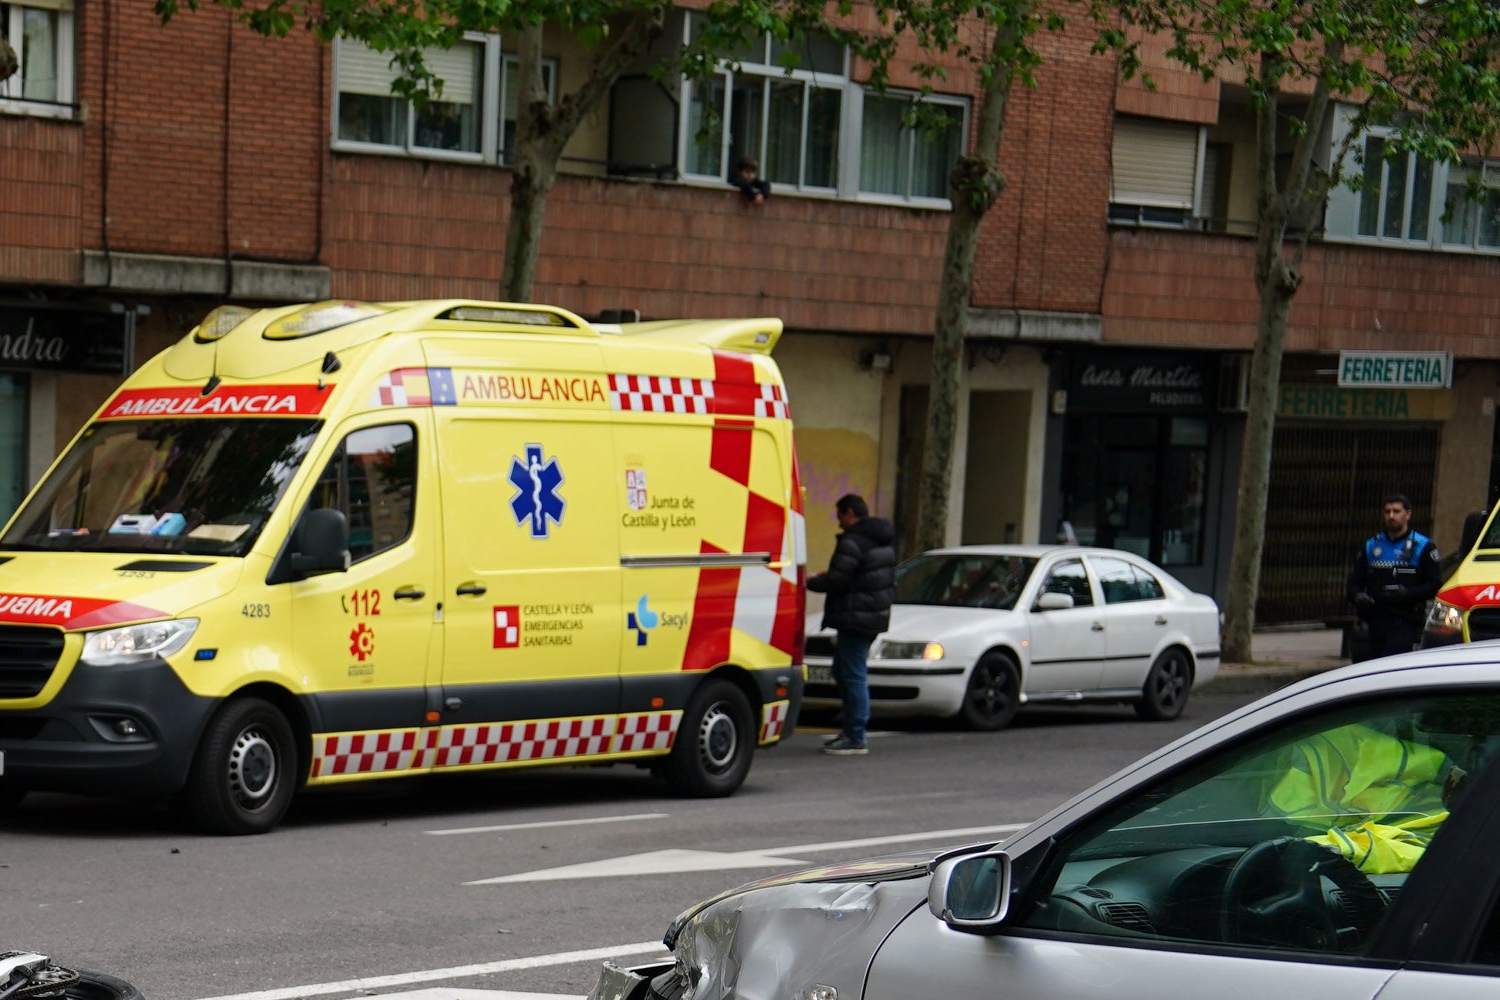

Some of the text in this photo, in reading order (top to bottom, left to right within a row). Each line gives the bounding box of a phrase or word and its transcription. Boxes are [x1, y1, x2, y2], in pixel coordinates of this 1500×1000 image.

[1341, 357, 1443, 382] FERRETERIA
[462, 375, 606, 402] AMBULANCIA
[110, 395, 297, 416] AMBULANCIA
[1280, 386, 1410, 417] FERRETERIA
[650, 495, 695, 509] Junta de
[621, 513, 696, 532] Castilla y León
[241, 603, 271, 618] 4283
[351, 589, 381, 617] 112
[523, 602, 594, 615] CASTILLA Y LEÓN
[524, 619, 583, 632] EMERGENCIAS
[661, 611, 688, 630] Sacyl
[524, 635, 573, 647] SANITARIAS
